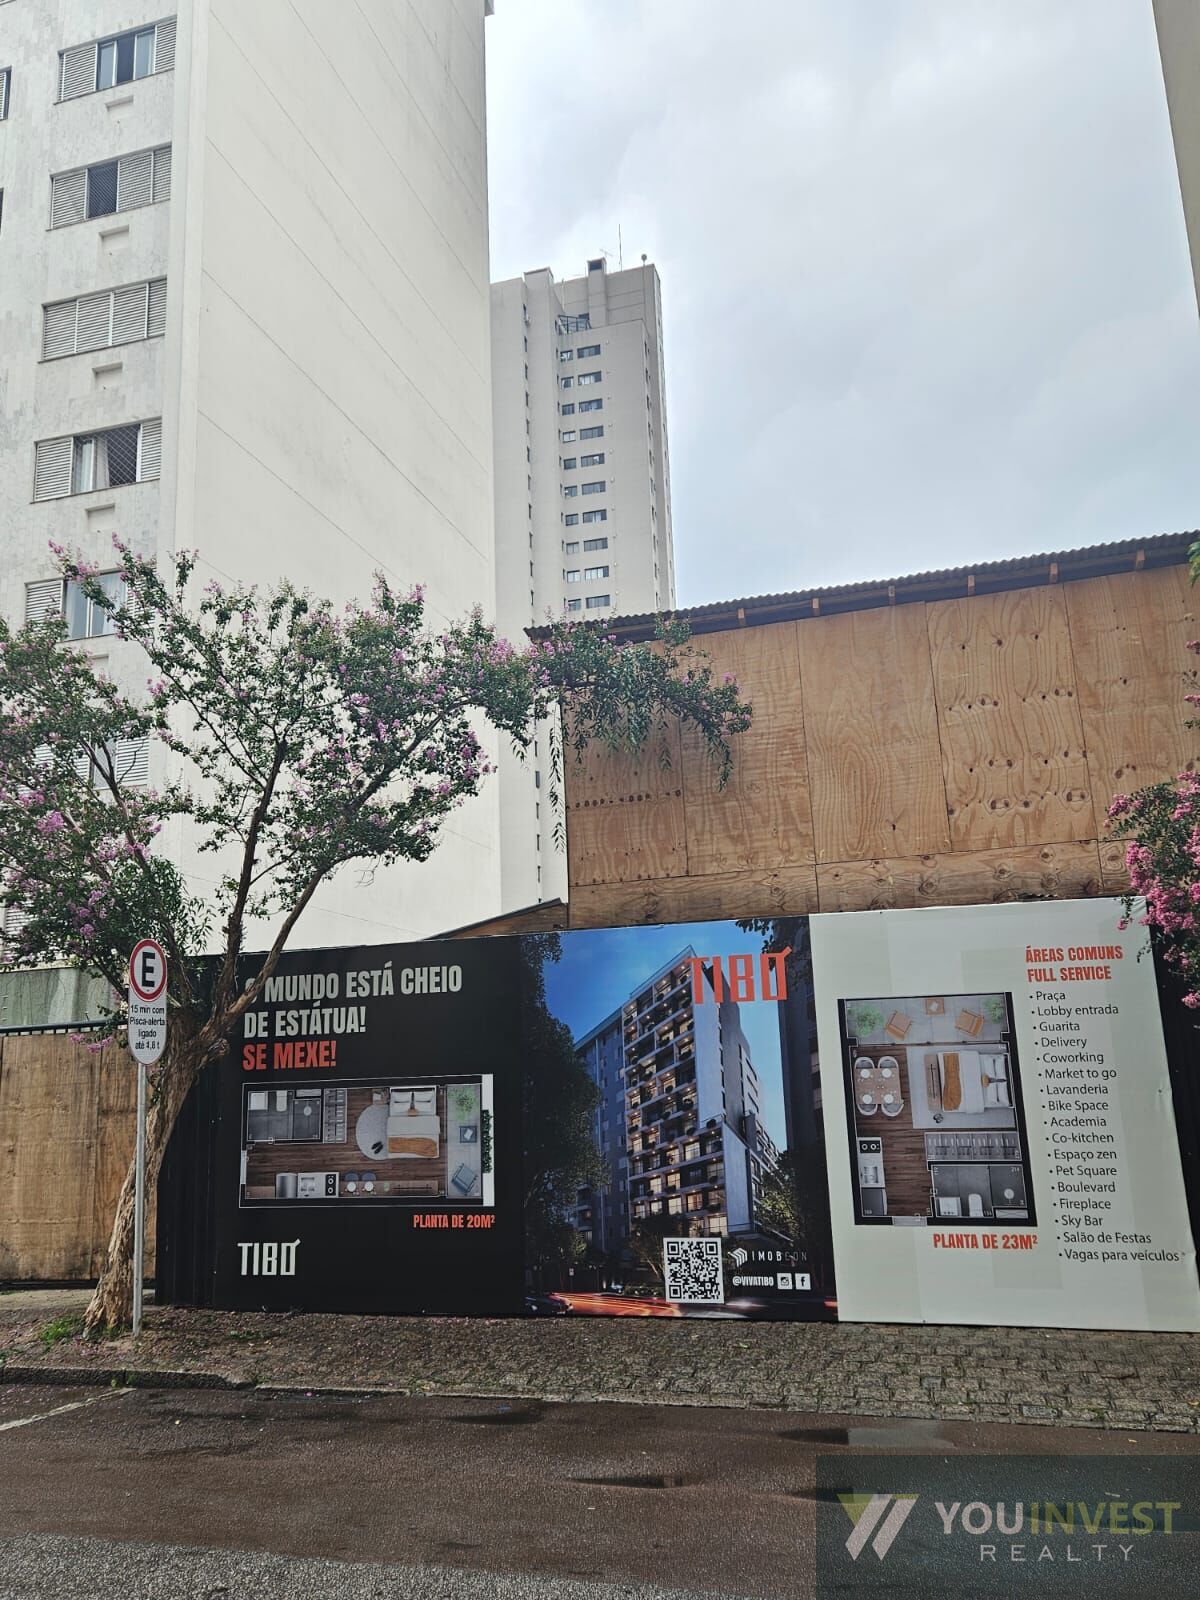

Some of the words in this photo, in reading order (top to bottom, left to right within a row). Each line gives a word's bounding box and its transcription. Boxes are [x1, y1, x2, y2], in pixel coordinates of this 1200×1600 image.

[1025, 945, 1064, 963] ÁREAS
[1068, 945, 1123, 961] COMUNS
[142, 951, 155, 988] E
[1027, 968, 1057, 982] FULL
[1060, 966, 1112, 981] SERVICE
[264, 973, 339, 1003] MUNDO
[346, 961, 394, 998] ESTÁ
[401, 965, 462, 995] CHEIO
[1035, 990, 1066, 1003] Praça
[131, 1004, 139, 1014] 15
[140, 1005, 151, 1014] min
[152, 1006, 165, 1014] com
[1037, 1005, 1072, 1018] Lobby
[1075, 1004, 1119, 1015] entrada
[244, 1011, 269, 1038] DE
[275, 1001, 366, 1037] ESTÁTUA!
[1039, 1021, 1080, 1031] Guarita
[138, 1028, 157, 1039] ligado
[1041, 1036, 1087, 1048] Delivery
[242, 1043, 267, 1071] SE
[273, 1040, 337, 1070] MEXE!
[1042, 1052, 1104, 1064] Coworking
[1045, 1068, 1084, 1079] Market
[1086, 1069, 1099, 1078] to
[1101, 1069, 1117, 1080] go
[1046, 1084, 1108, 1095] Lavanderia
[1048, 1100, 1072, 1111] Bike
[1075, 1100, 1109, 1112] Space
[1050, 1116, 1107, 1127] Academia
[1052, 1132, 1114, 1143] Co-kitchen
[1054, 1149, 1094, 1162] Espaço
[1096, 1150, 1117, 1159] zen
[1056, 1165, 1074, 1176] Pet
[1077, 1165, 1117, 1178] Square
[1057, 1181, 1116, 1192] Boulevard
[1059, 1198, 1111, 1211] Fireplace
[413, 1214, 449, 1228] PLANTA
[451, 1214, 464, 1228] DE
[1061, 1214, 1081, 1228] Sky
[1084, 1215, 1103, 1226] Bar
[933, 1233, 979, 1248] PLANTA
[981, 1234, 998, 1249] DE
[1063, 1231, 1094, 1243] Salão
[1097, 1231, 1112, 1243] de
[1115, 1232, 1151, 1244] Festas
[1064, 1248, 1099, 1262] Vagas
[1102, 1251, 1128, 1262] para
[732, 1275, 774, 1287] @VIVATIBO
